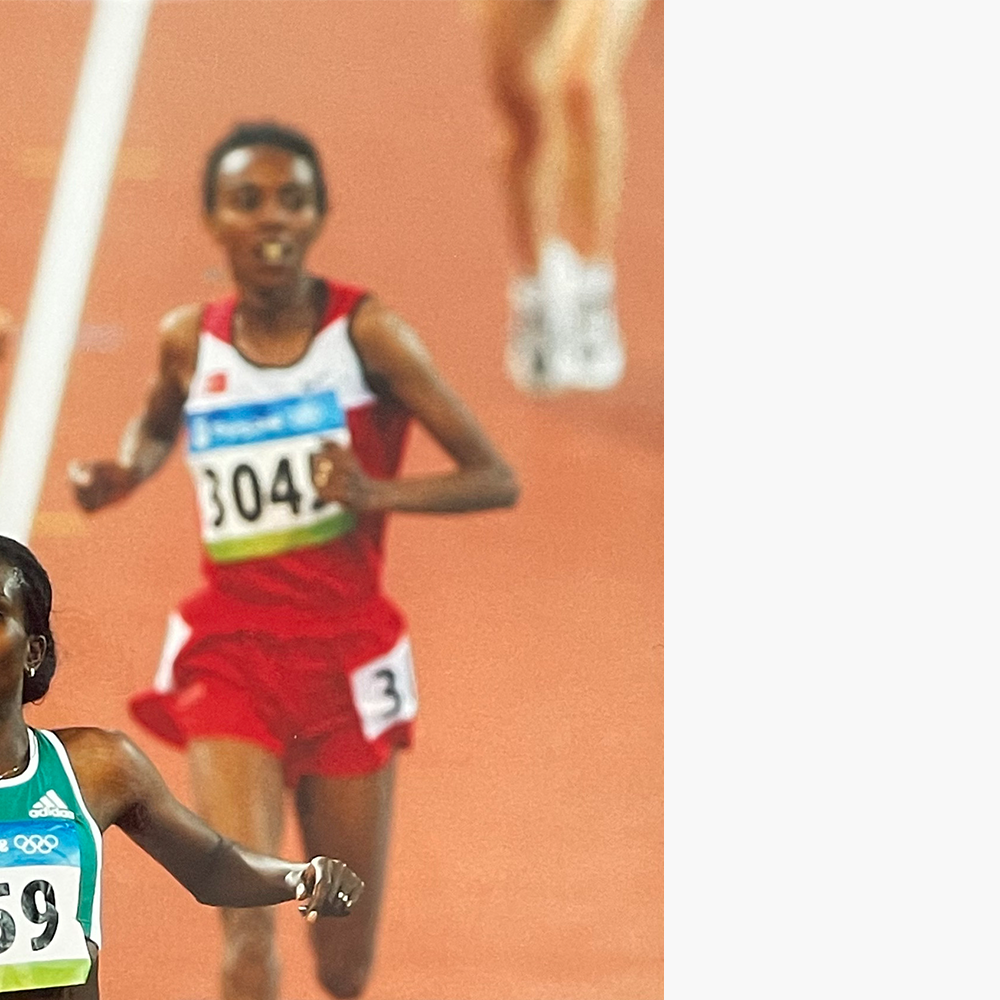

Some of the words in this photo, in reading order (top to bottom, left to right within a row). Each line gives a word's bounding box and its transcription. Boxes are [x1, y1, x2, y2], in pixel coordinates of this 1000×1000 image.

[205, 458, 328, 526] 304
[375, 668, 401, 718] 3
[28, 807, 75, 820] adidas
